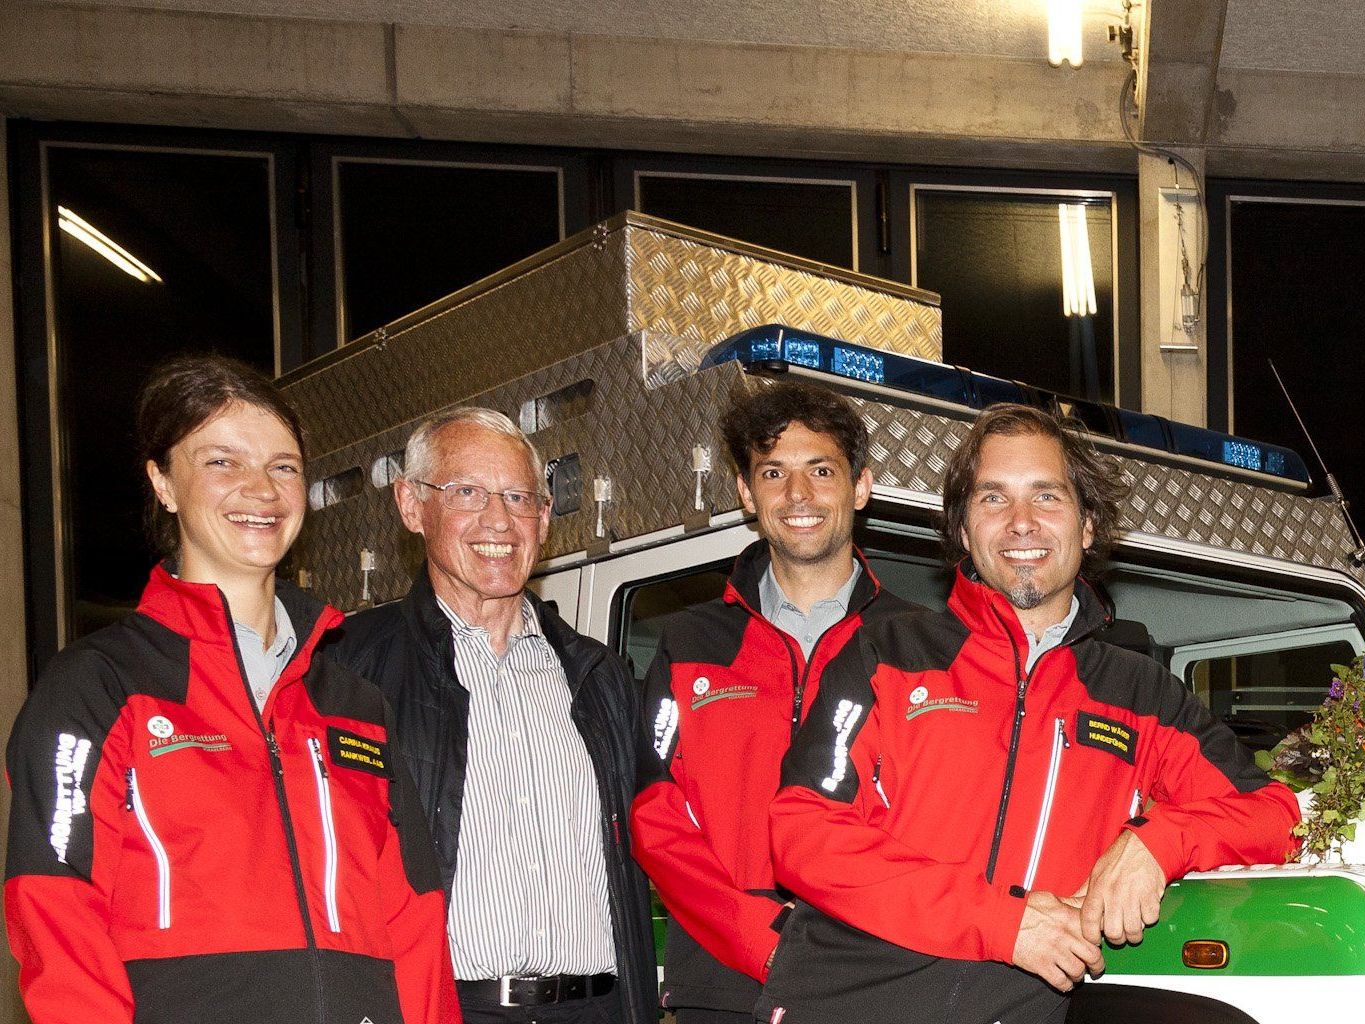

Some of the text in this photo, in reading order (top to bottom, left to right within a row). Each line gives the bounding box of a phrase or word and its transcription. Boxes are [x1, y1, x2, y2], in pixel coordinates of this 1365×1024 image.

[922, 696, 979, 706] Bergrettung
[149, 733, 228, 748] Die Bergrettung
